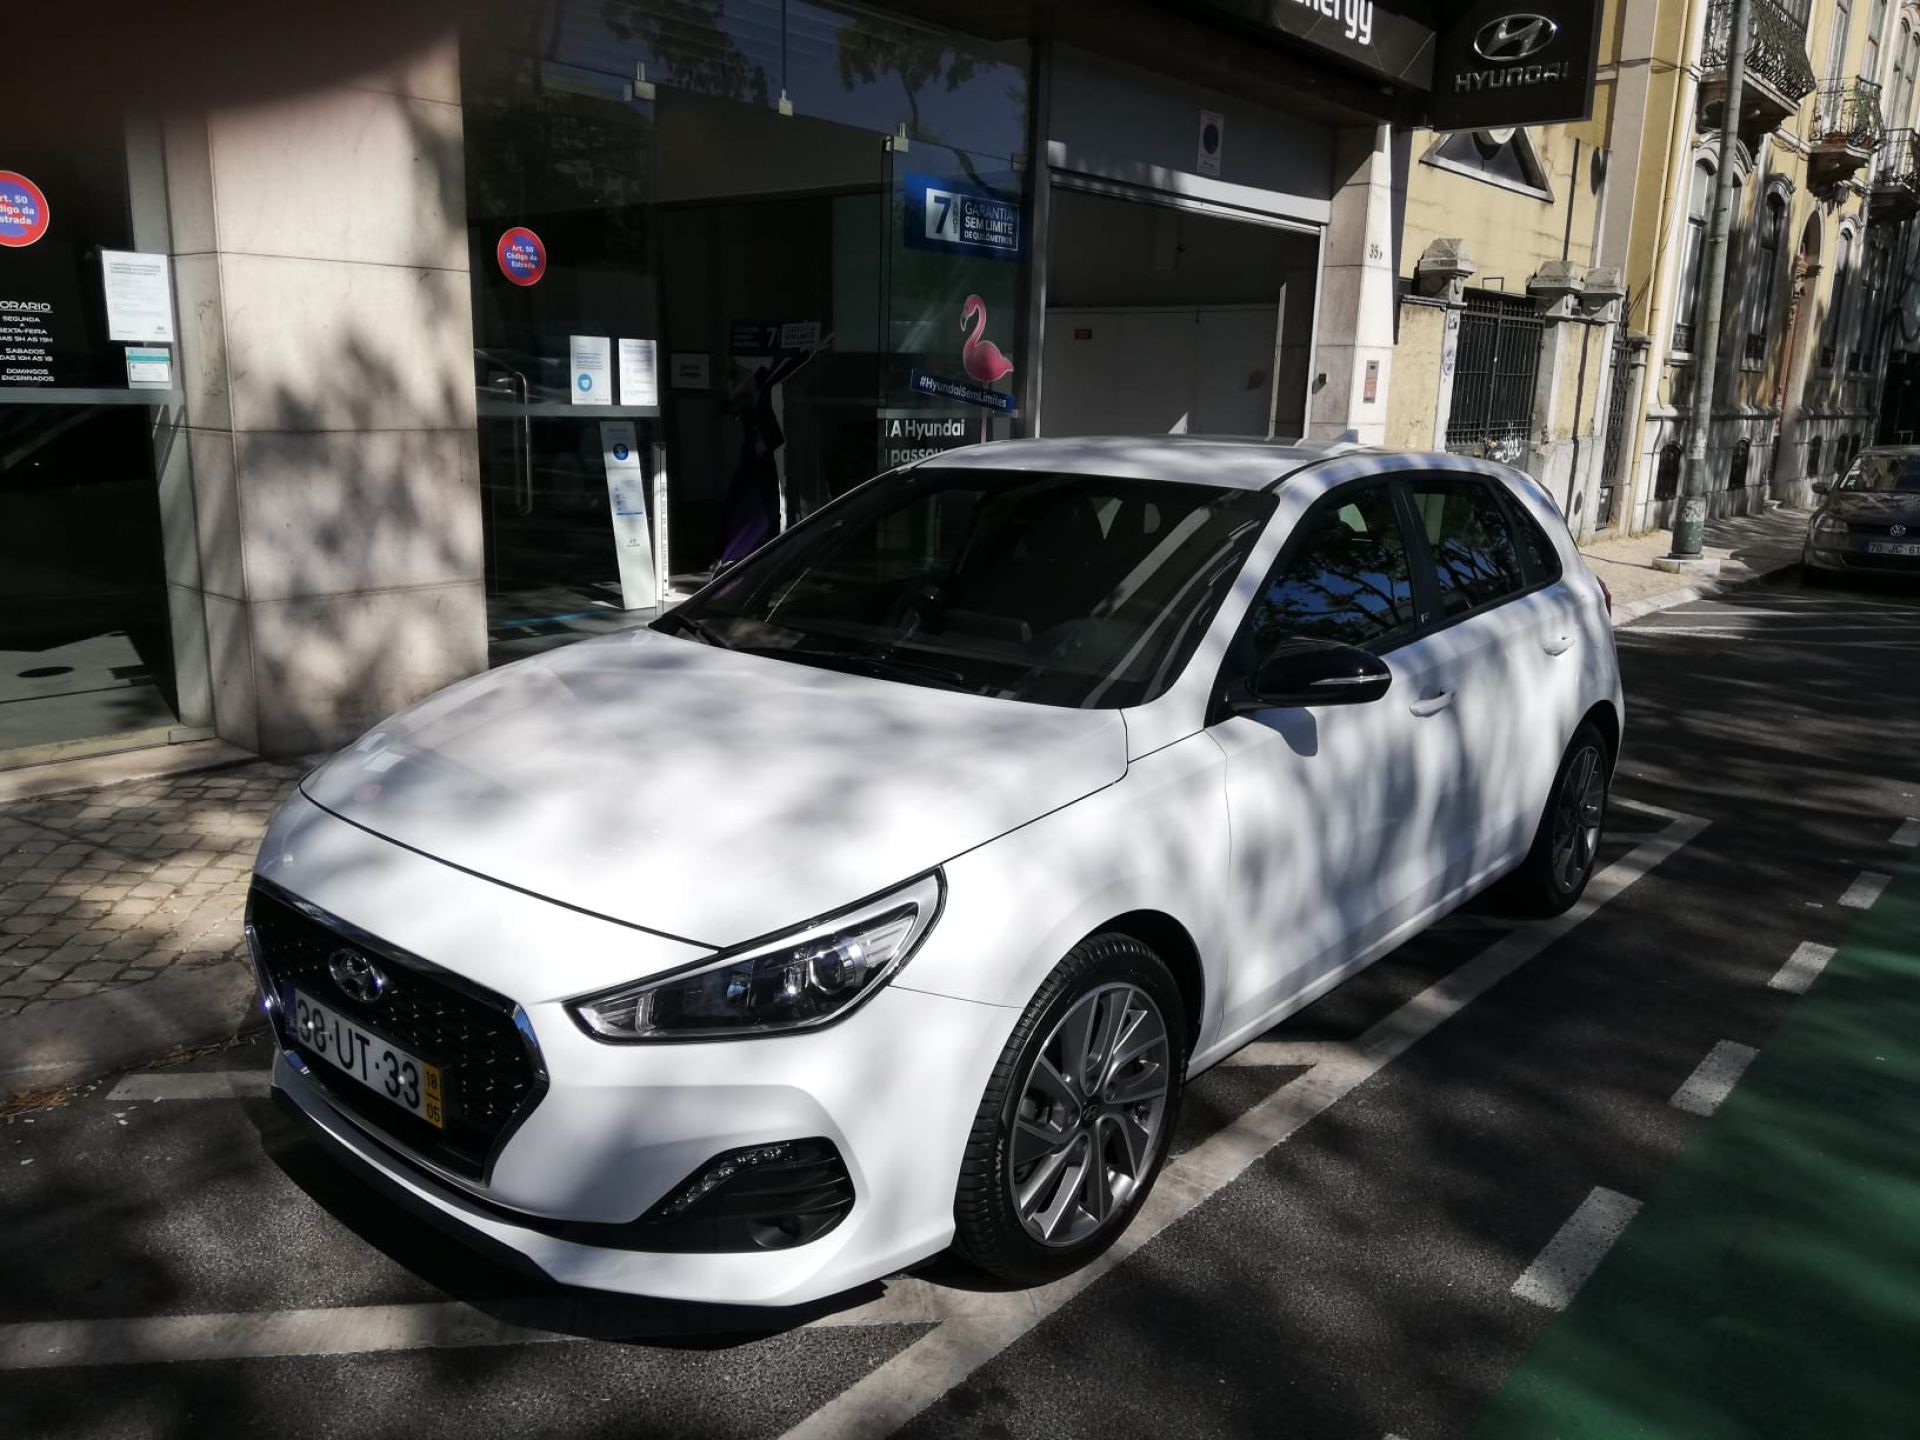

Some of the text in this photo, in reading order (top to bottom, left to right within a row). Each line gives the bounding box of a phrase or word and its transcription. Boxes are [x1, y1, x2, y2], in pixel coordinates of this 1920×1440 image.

[1291, 0, 1374, 46] ergy
[1455, 61, 1569, 93] HYUNDAI
[0, 194, 28, 204] rt. 50
[0, 204, 35, 215] digo da
[933, 195, 952, 234] 7
[965, 201, 1014, 222] GARANTIA
[0, 215, 33, 225] strada
[965, 216, 1014, 235] SEM LIMITE
[0, 300, 51, 311] ORARIO
[6, 367, 49, 375] DOMINGOS
[919, 376, 1007, 408] #HyundaiSemLimites
[890, 418, 965, 440] A Hyundai
[891, 447, 944, 467] passo
[425, 1071, 438, 1090] 18
[426, 1103, 440, 1122] 05
